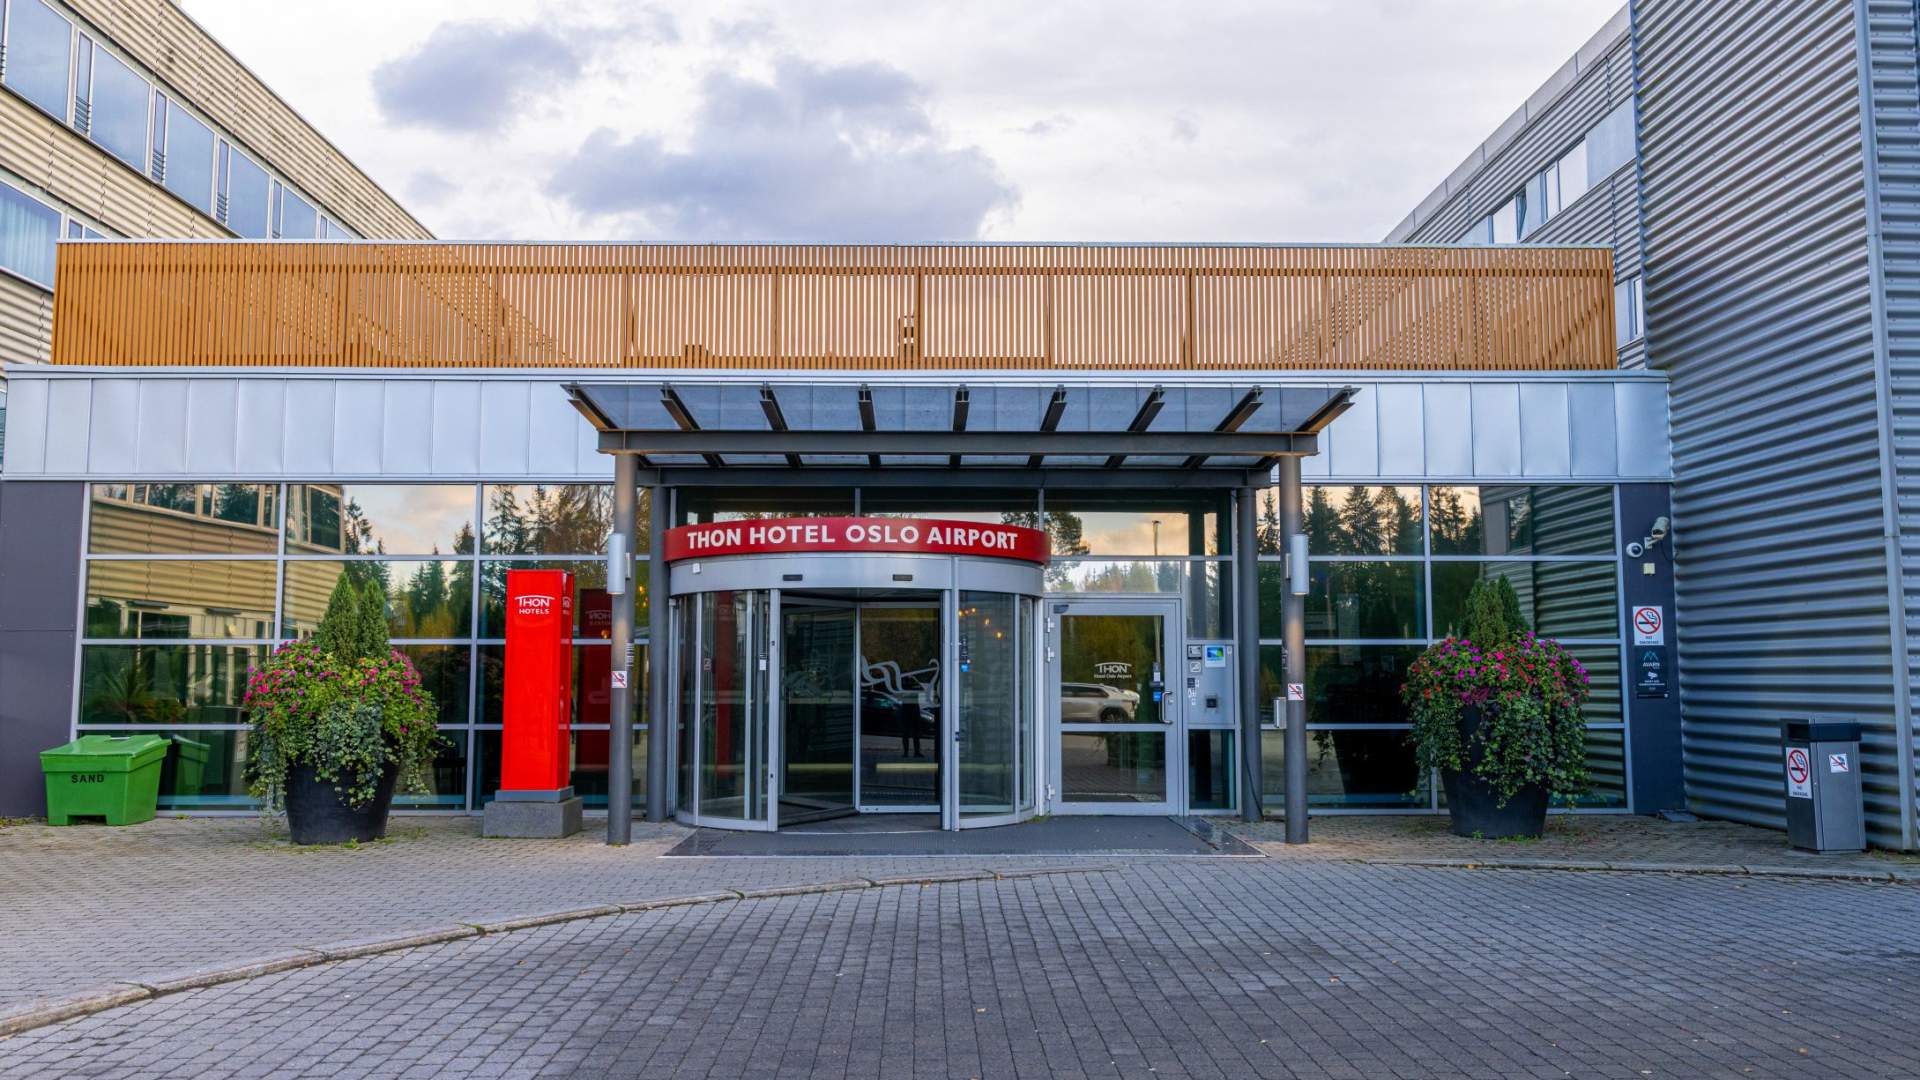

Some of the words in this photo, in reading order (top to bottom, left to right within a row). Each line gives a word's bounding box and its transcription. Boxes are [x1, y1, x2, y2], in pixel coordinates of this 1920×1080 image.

[687, 527, 742, 550] THON
[749, 525, 835, 545] HOTEL
[845, 525, 919, 544] OSLO
[926, 526, 1018, 550] AIRPORT
[514, 594, 555, 608] THON
[1094, 662, 1132, 674] THON
[71, 773, 105, 784] SAND
